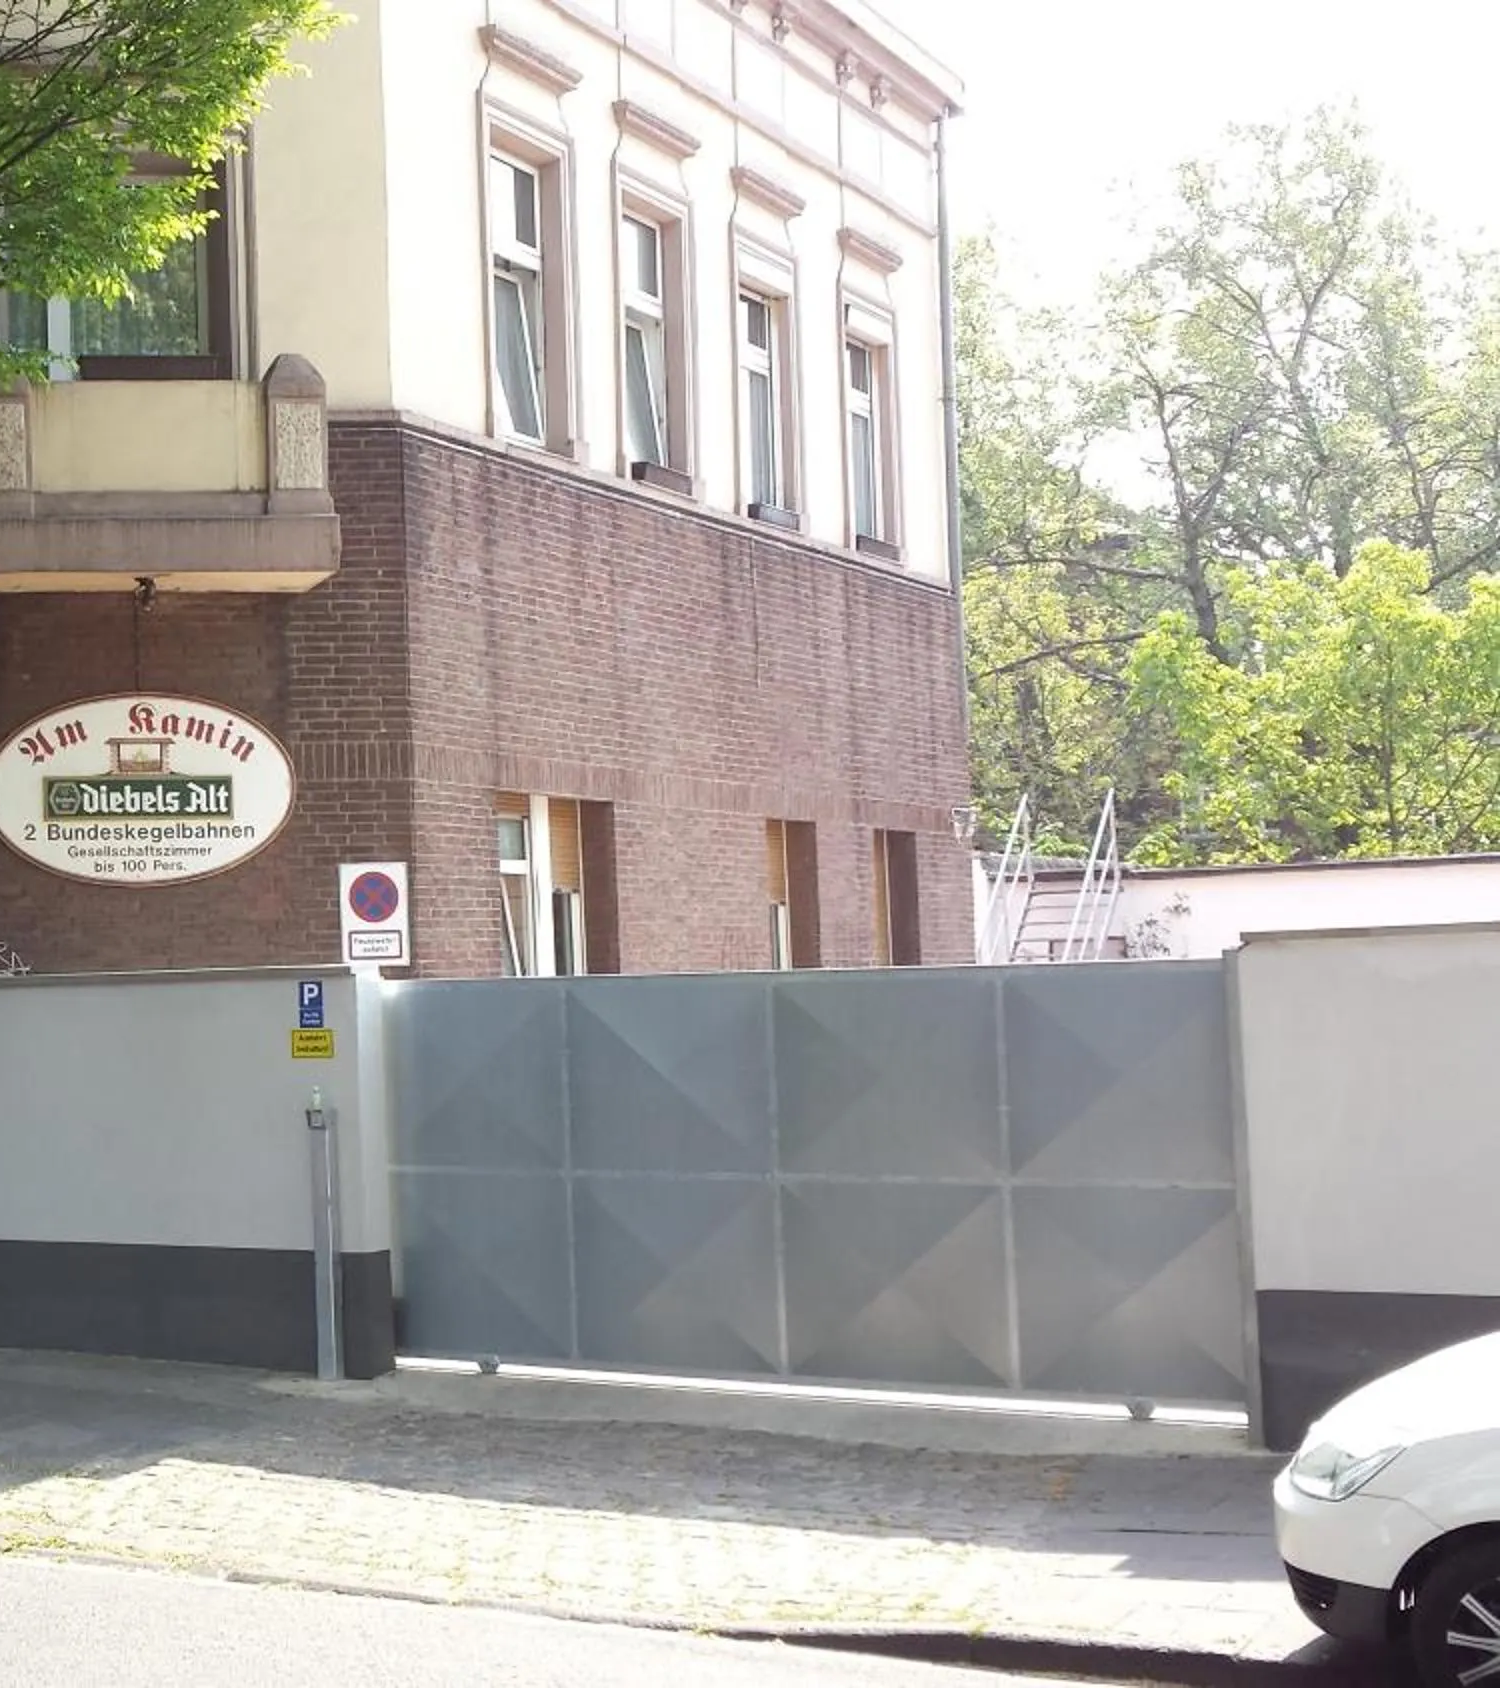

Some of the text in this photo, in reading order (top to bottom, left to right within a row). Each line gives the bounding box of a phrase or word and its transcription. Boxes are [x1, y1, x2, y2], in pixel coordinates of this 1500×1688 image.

[19, 702, 256, 766] Am Kamin
[80, 783, 229, 814] Diebels Alt
[23, 823, 255, 842] 2 Bundeskegelbahnen
[67, 845, 213, 858] Gesellschaftszimmer
[94, 860, 187, 873] bis 100 Pers.
[303, 983, 318, 1005] P
